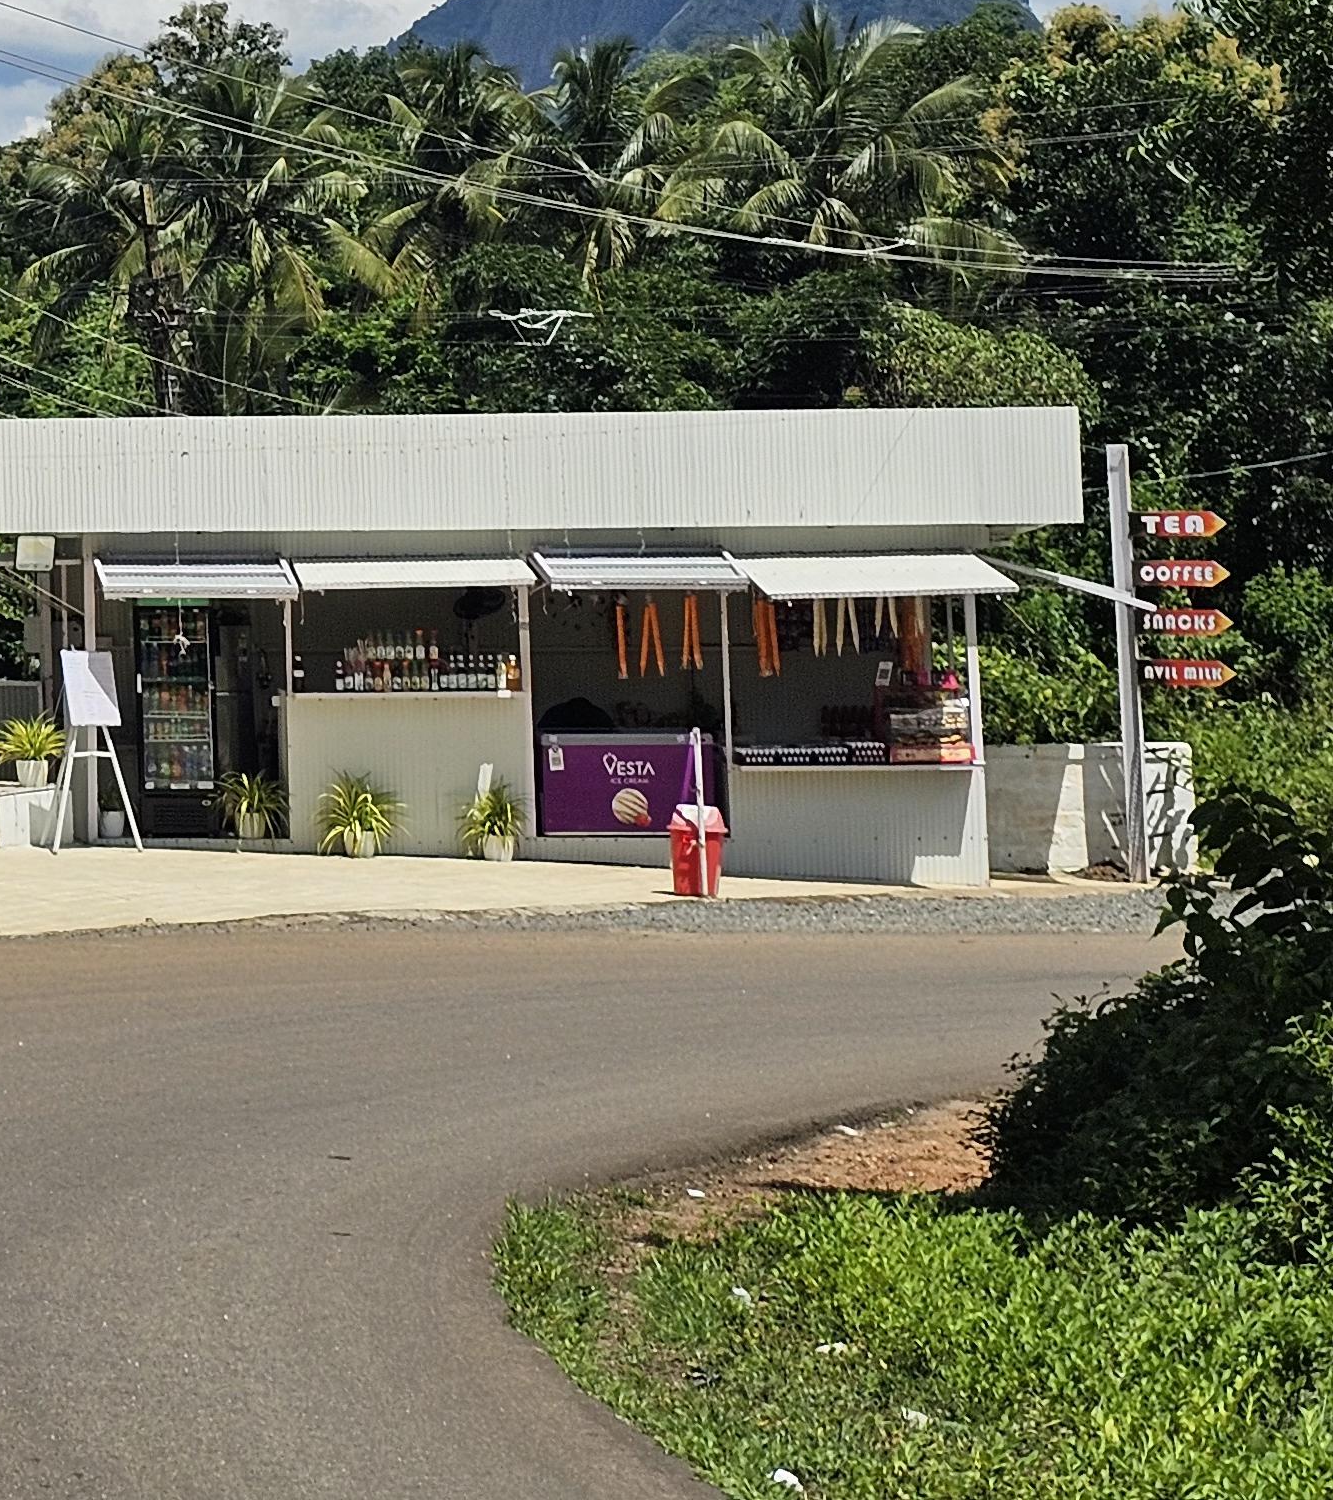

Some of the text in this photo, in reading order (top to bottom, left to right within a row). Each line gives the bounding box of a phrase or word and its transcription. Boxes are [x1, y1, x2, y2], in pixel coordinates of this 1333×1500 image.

[1140, 514, 1205, 535] TEA
[1139, 565, 1214, 583] COFFEE
[1142, 613, 1216, 631] SNACKS
[1144, 665, 1223, 681] AVIL MILK
[602, 752, 656, 776] VESTA
